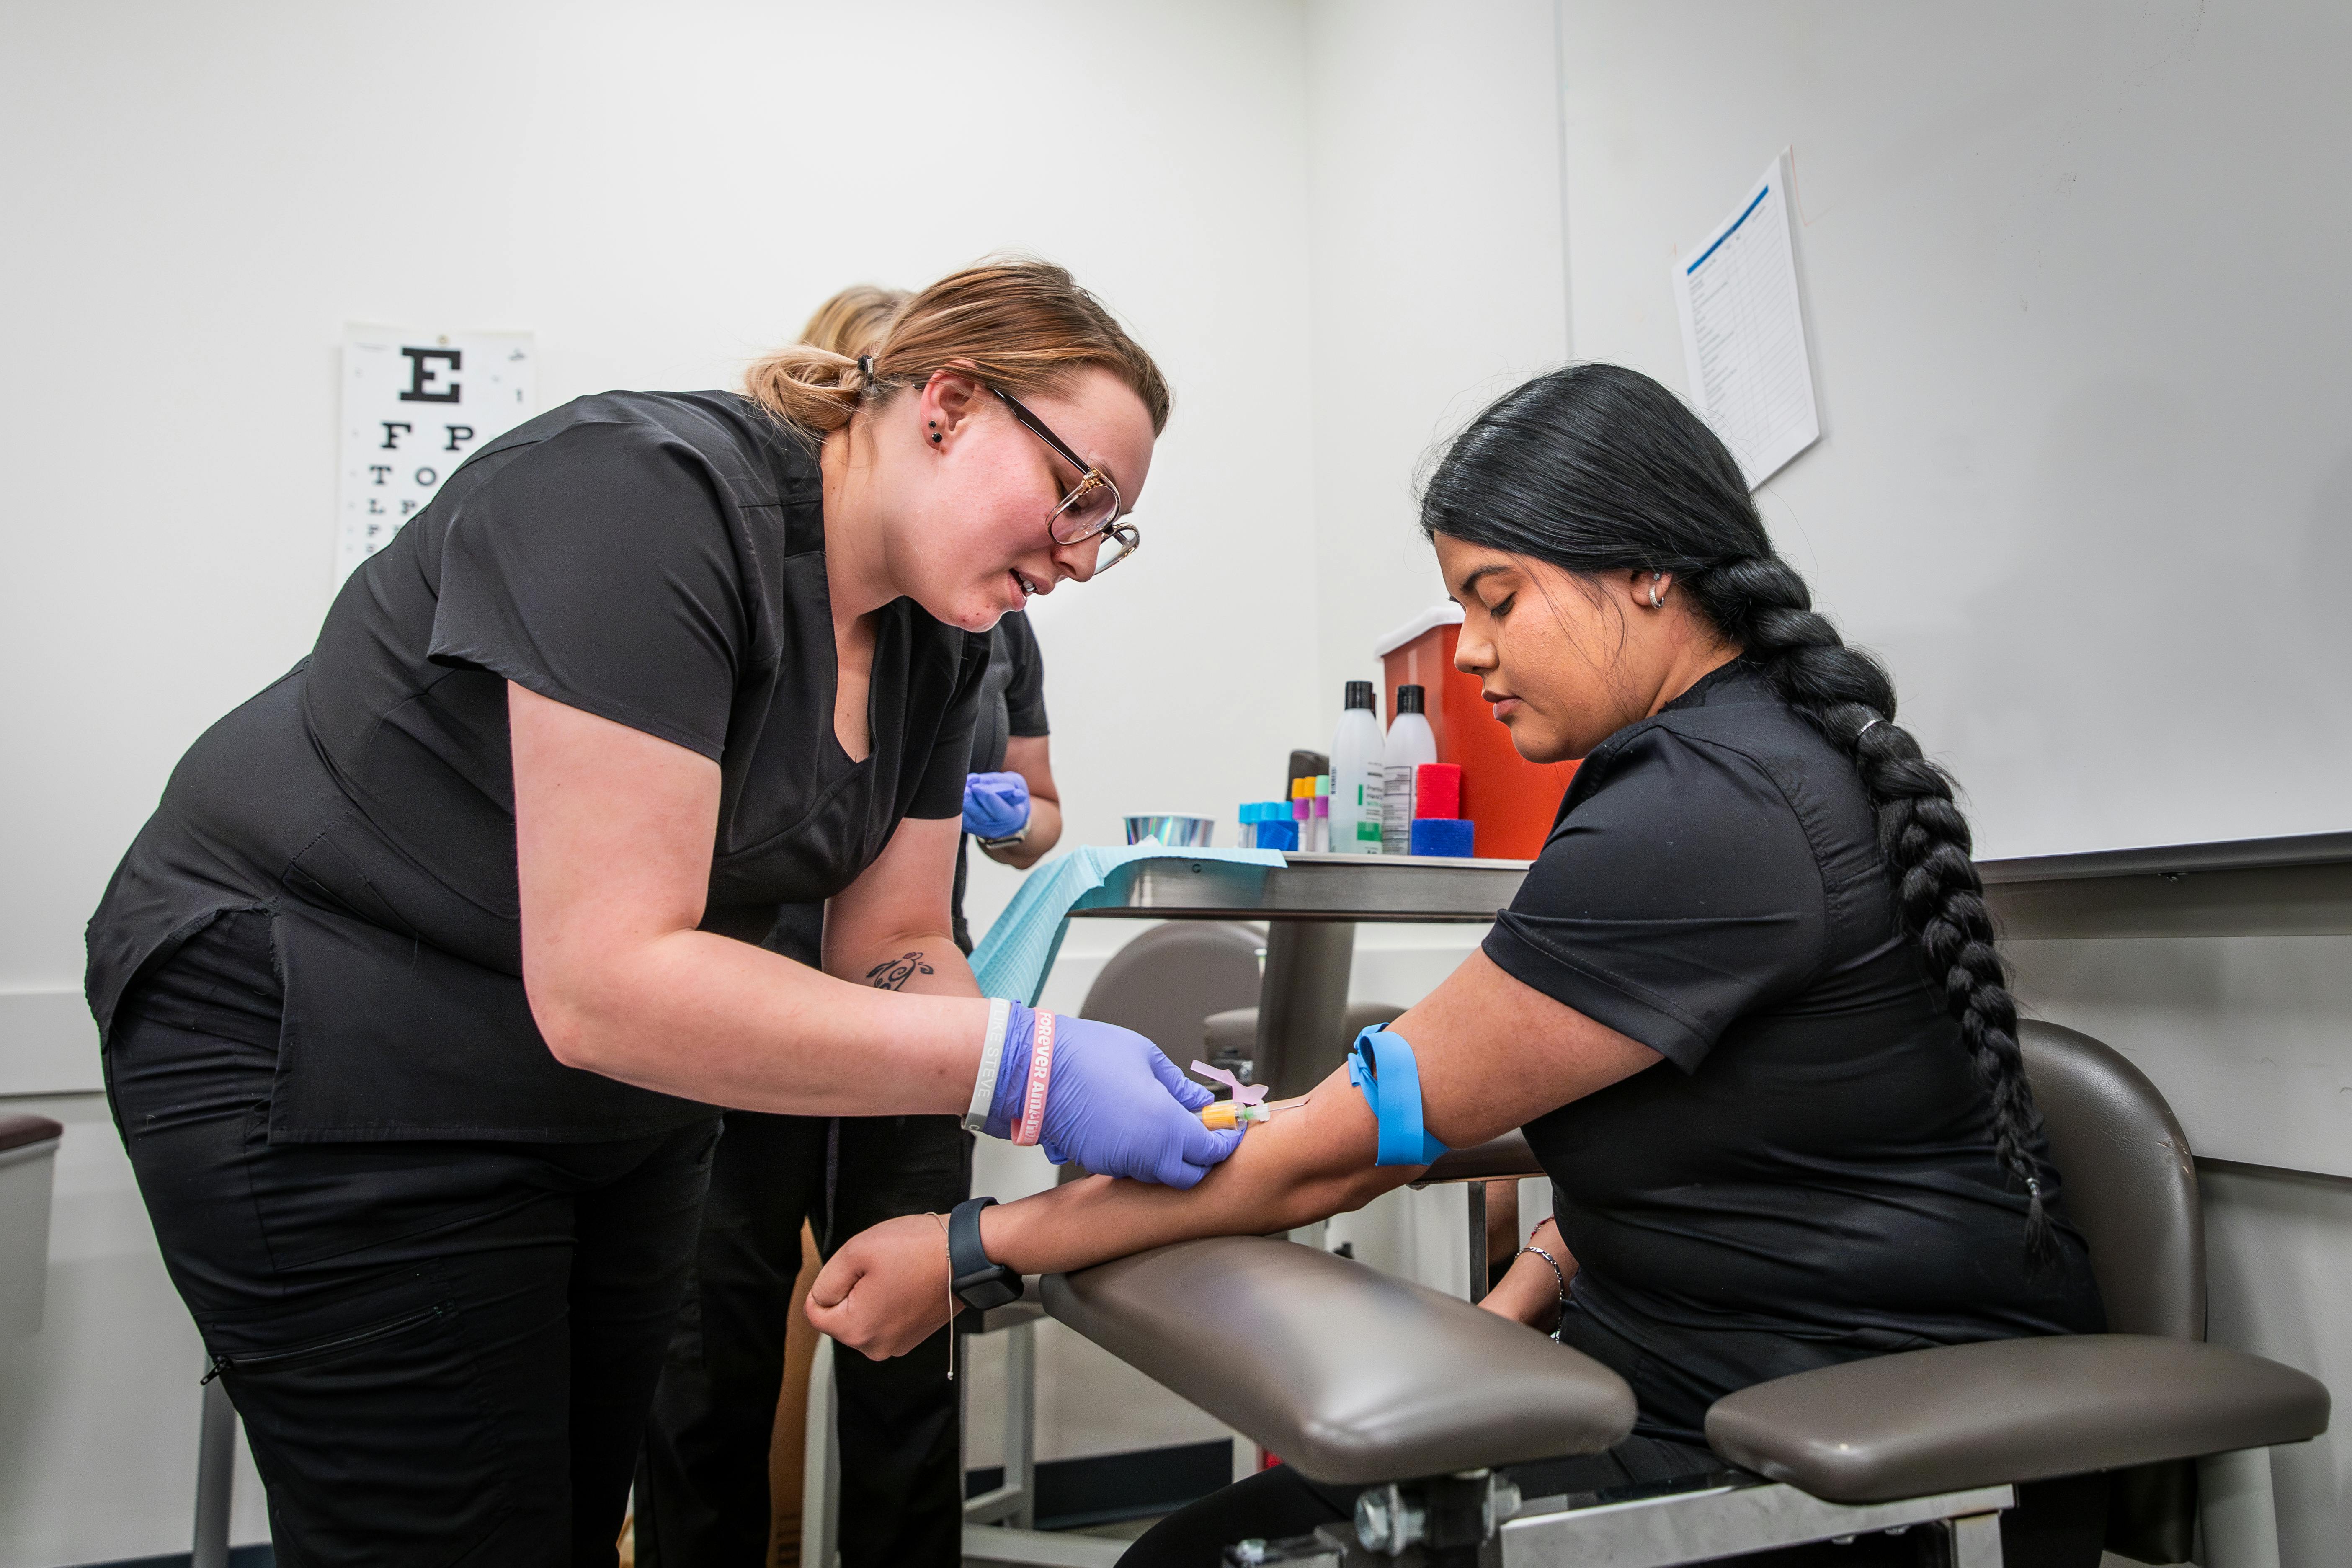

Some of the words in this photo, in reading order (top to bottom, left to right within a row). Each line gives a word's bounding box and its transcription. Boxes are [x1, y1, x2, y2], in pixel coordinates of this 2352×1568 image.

[399, 346, 462, 404] E
[381, 422, 412, 449] F
[444, 425, 474, 451] P
[369, 465, 392, 485] T
[415, 467, 437, 487] O
[989, 1009, 1006, 1043] LIKE
[977, 1047, 999, 1098] STEVE
